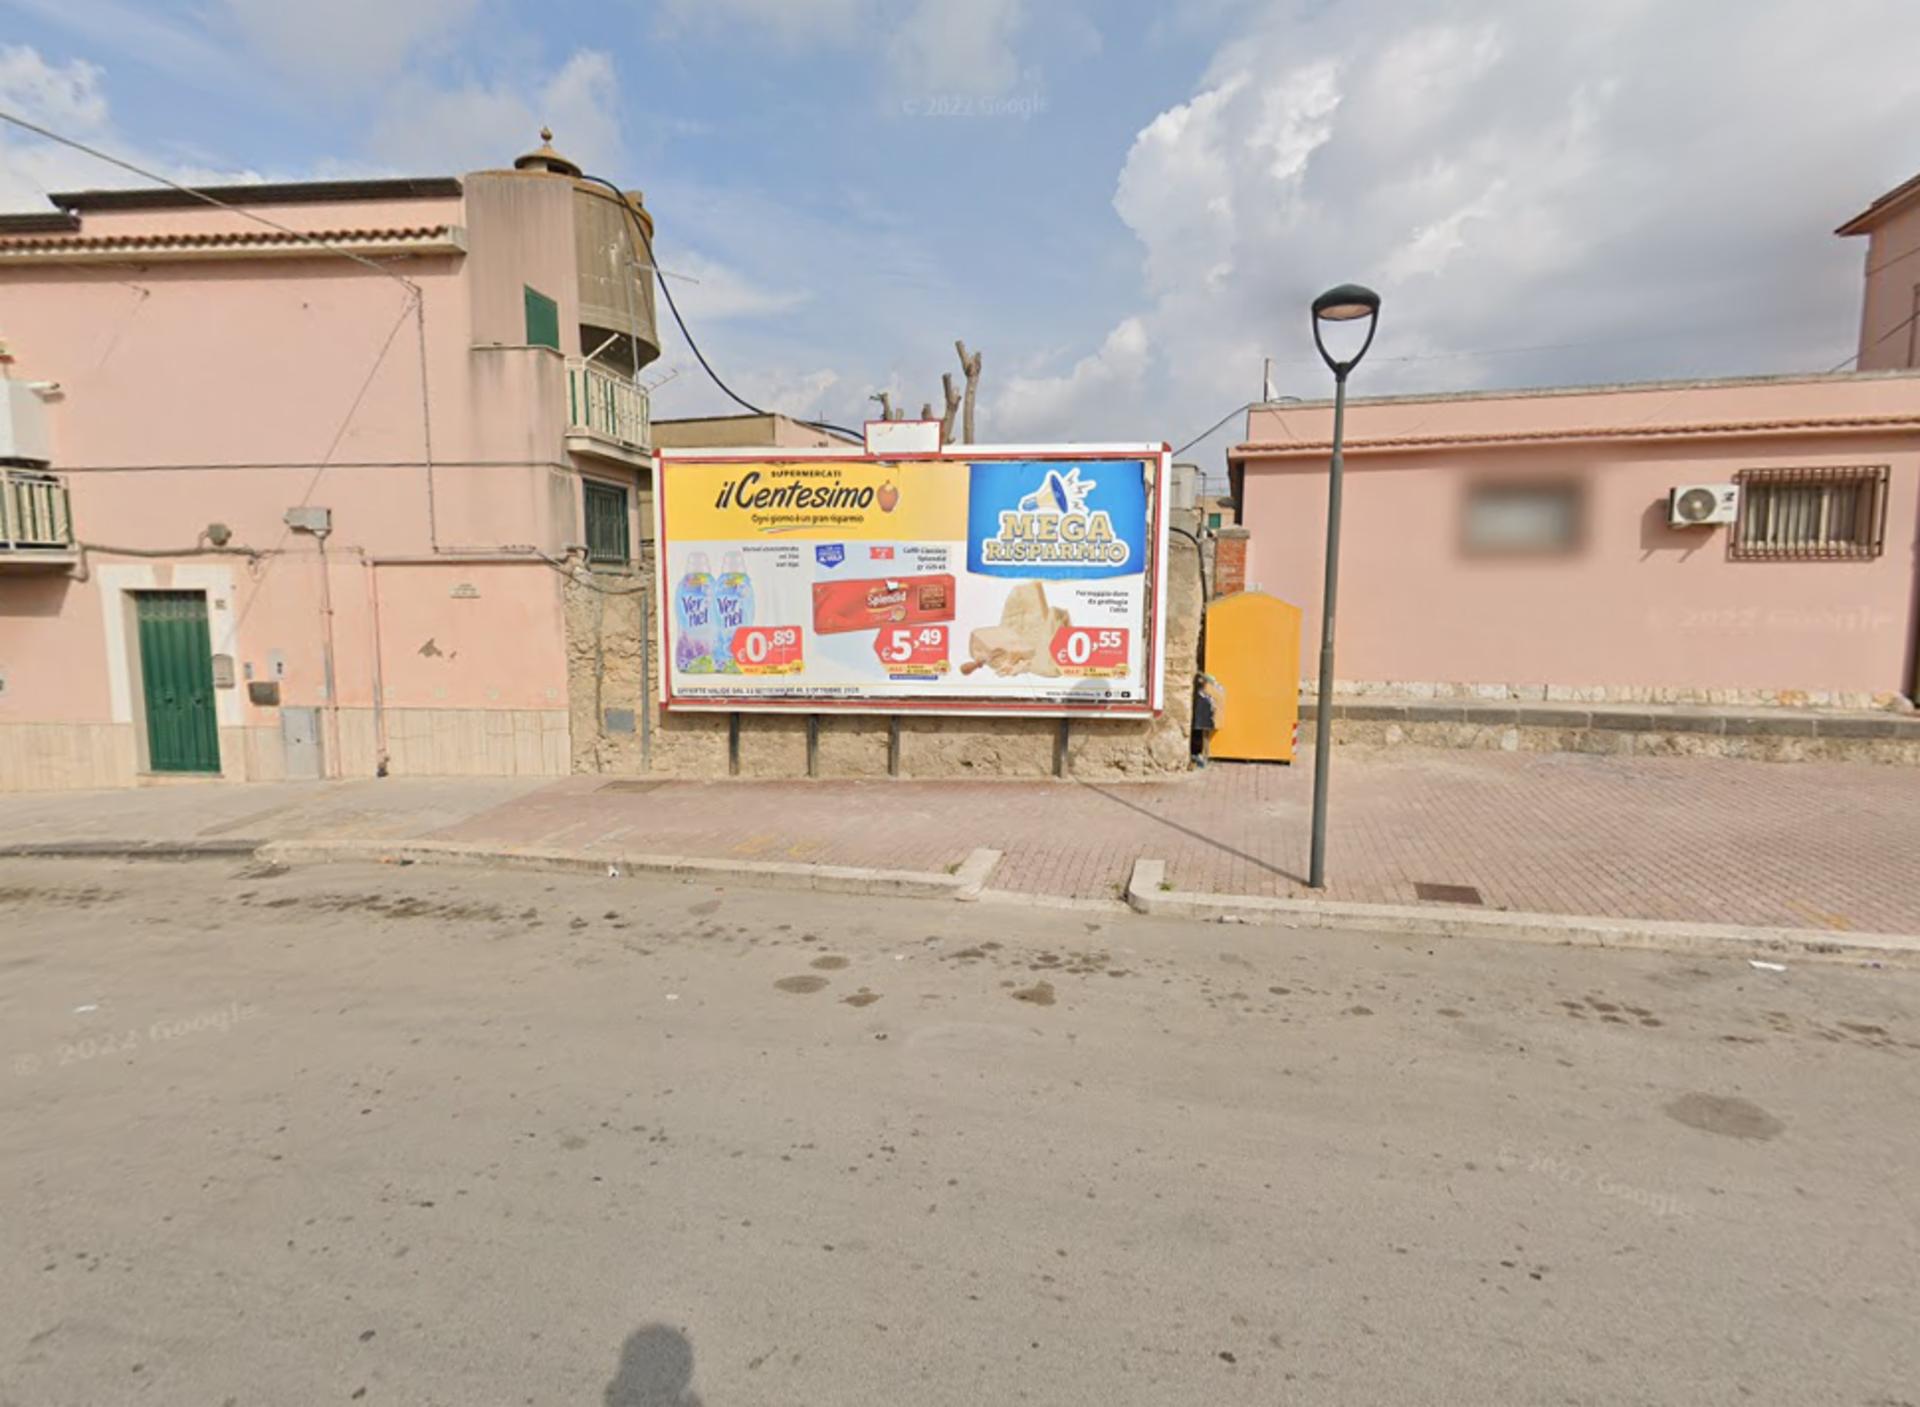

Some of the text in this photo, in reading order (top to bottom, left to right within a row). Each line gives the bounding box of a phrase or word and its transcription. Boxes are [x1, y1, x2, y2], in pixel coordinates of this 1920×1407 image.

[771, 470, 842, 478] SUPERMERCATI
[735, 471, 874, 509] Centesimo
[752, 514, 769, 524] Ogni
[771, 514, 795, 524] giorno
[812, 515, 829, 524] gran
[830, 514, 864, 524] risparmio
[1000, 513, 1113, 543] MEGA
[986, 541, 1127, 562] RISPARMIO
